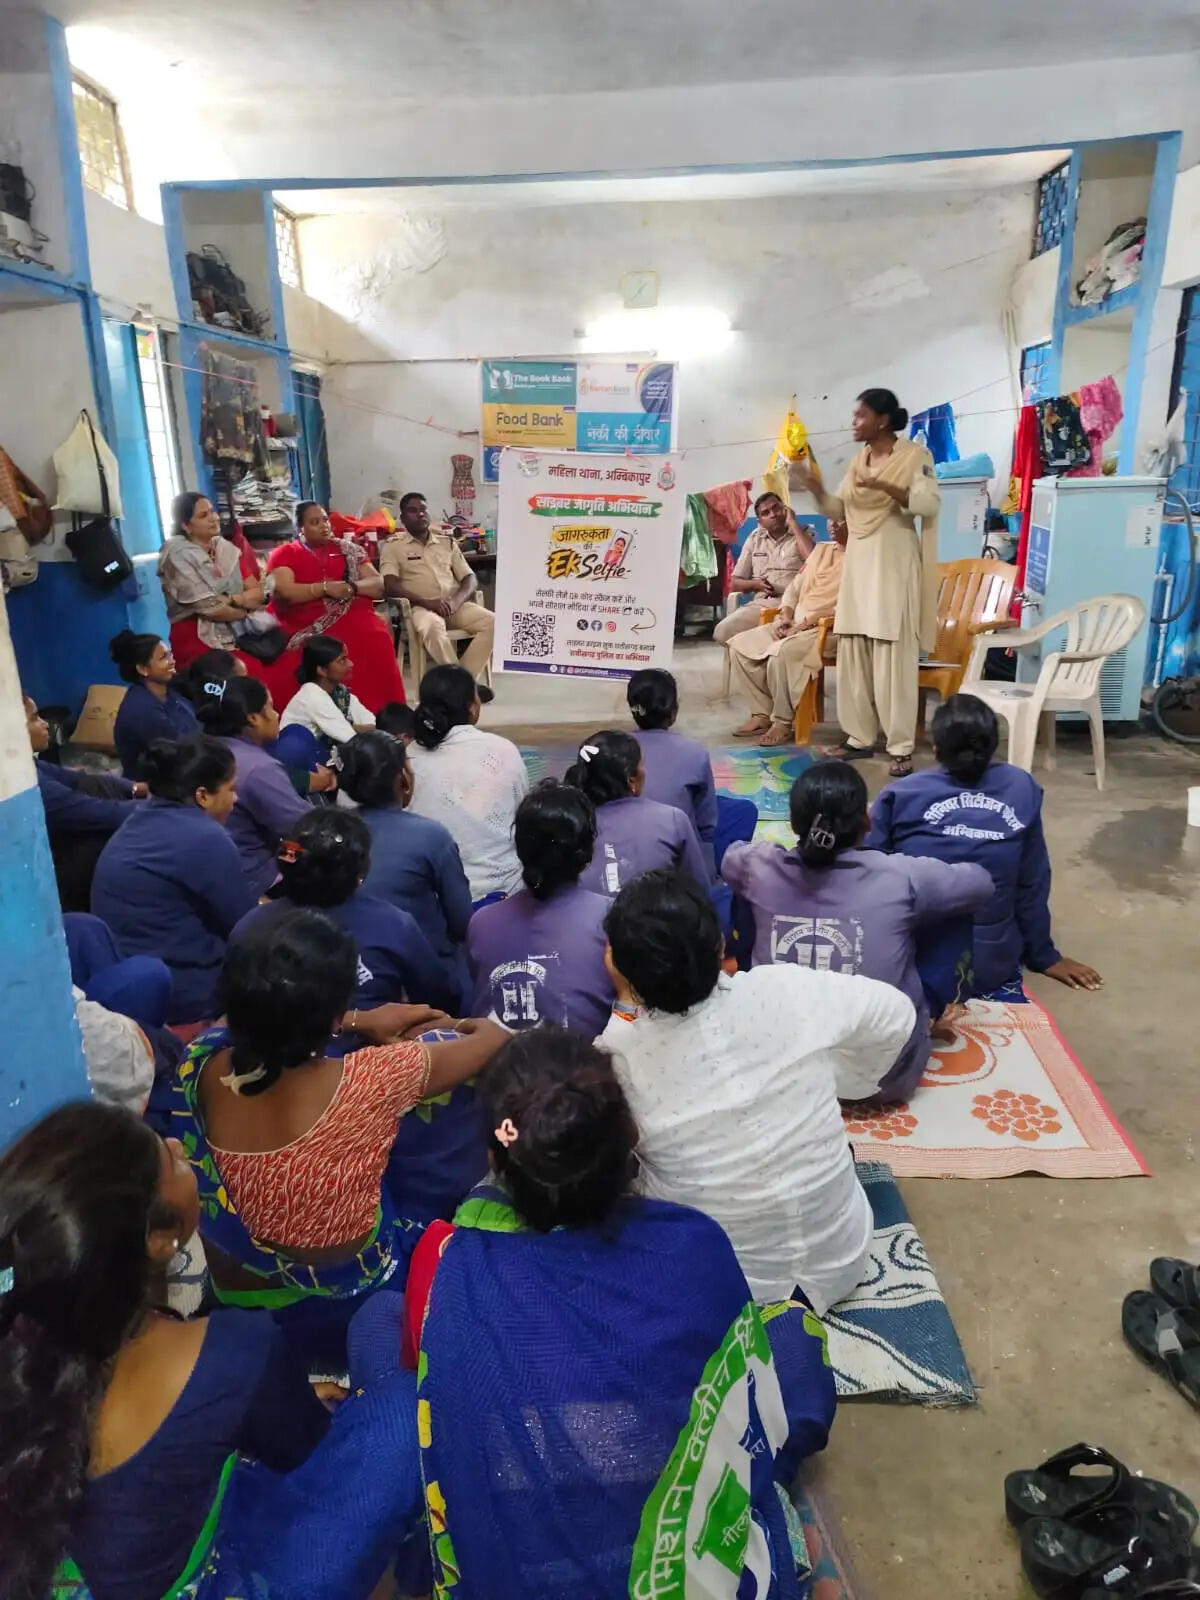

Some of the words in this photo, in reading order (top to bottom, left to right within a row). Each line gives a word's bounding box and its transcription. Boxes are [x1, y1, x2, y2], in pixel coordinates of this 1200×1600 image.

[496, 412, 528, 426] Food
[532, 413, 564, 427] Bank
[548, 464, 577, 479] महिला
[606, 468, 651, 487] अम्बिकापुर
[607, 499, 653, 516] अभियान
[598, 605, 620, 614] SHARE
[633, 1484, 694, 1600] मिशन
[690, 1360, 732, 1463] क्लीन
